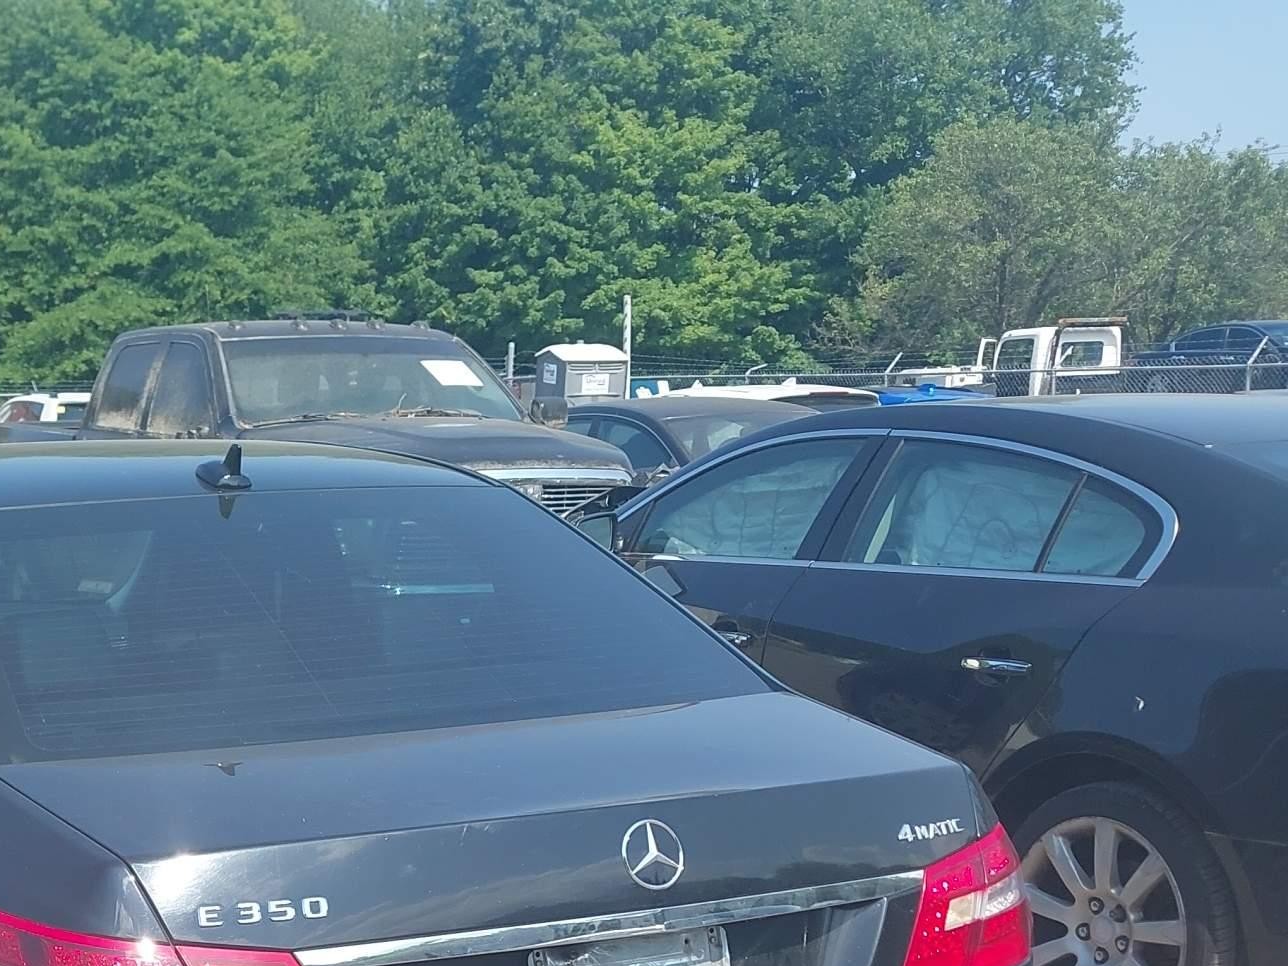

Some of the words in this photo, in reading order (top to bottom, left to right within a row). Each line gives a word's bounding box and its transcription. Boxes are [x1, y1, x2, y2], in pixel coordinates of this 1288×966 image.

[898, 818, 965, 842] 4MATIC
[198, 905, 224, 927] E
[237, 897, 329, 925] 350
